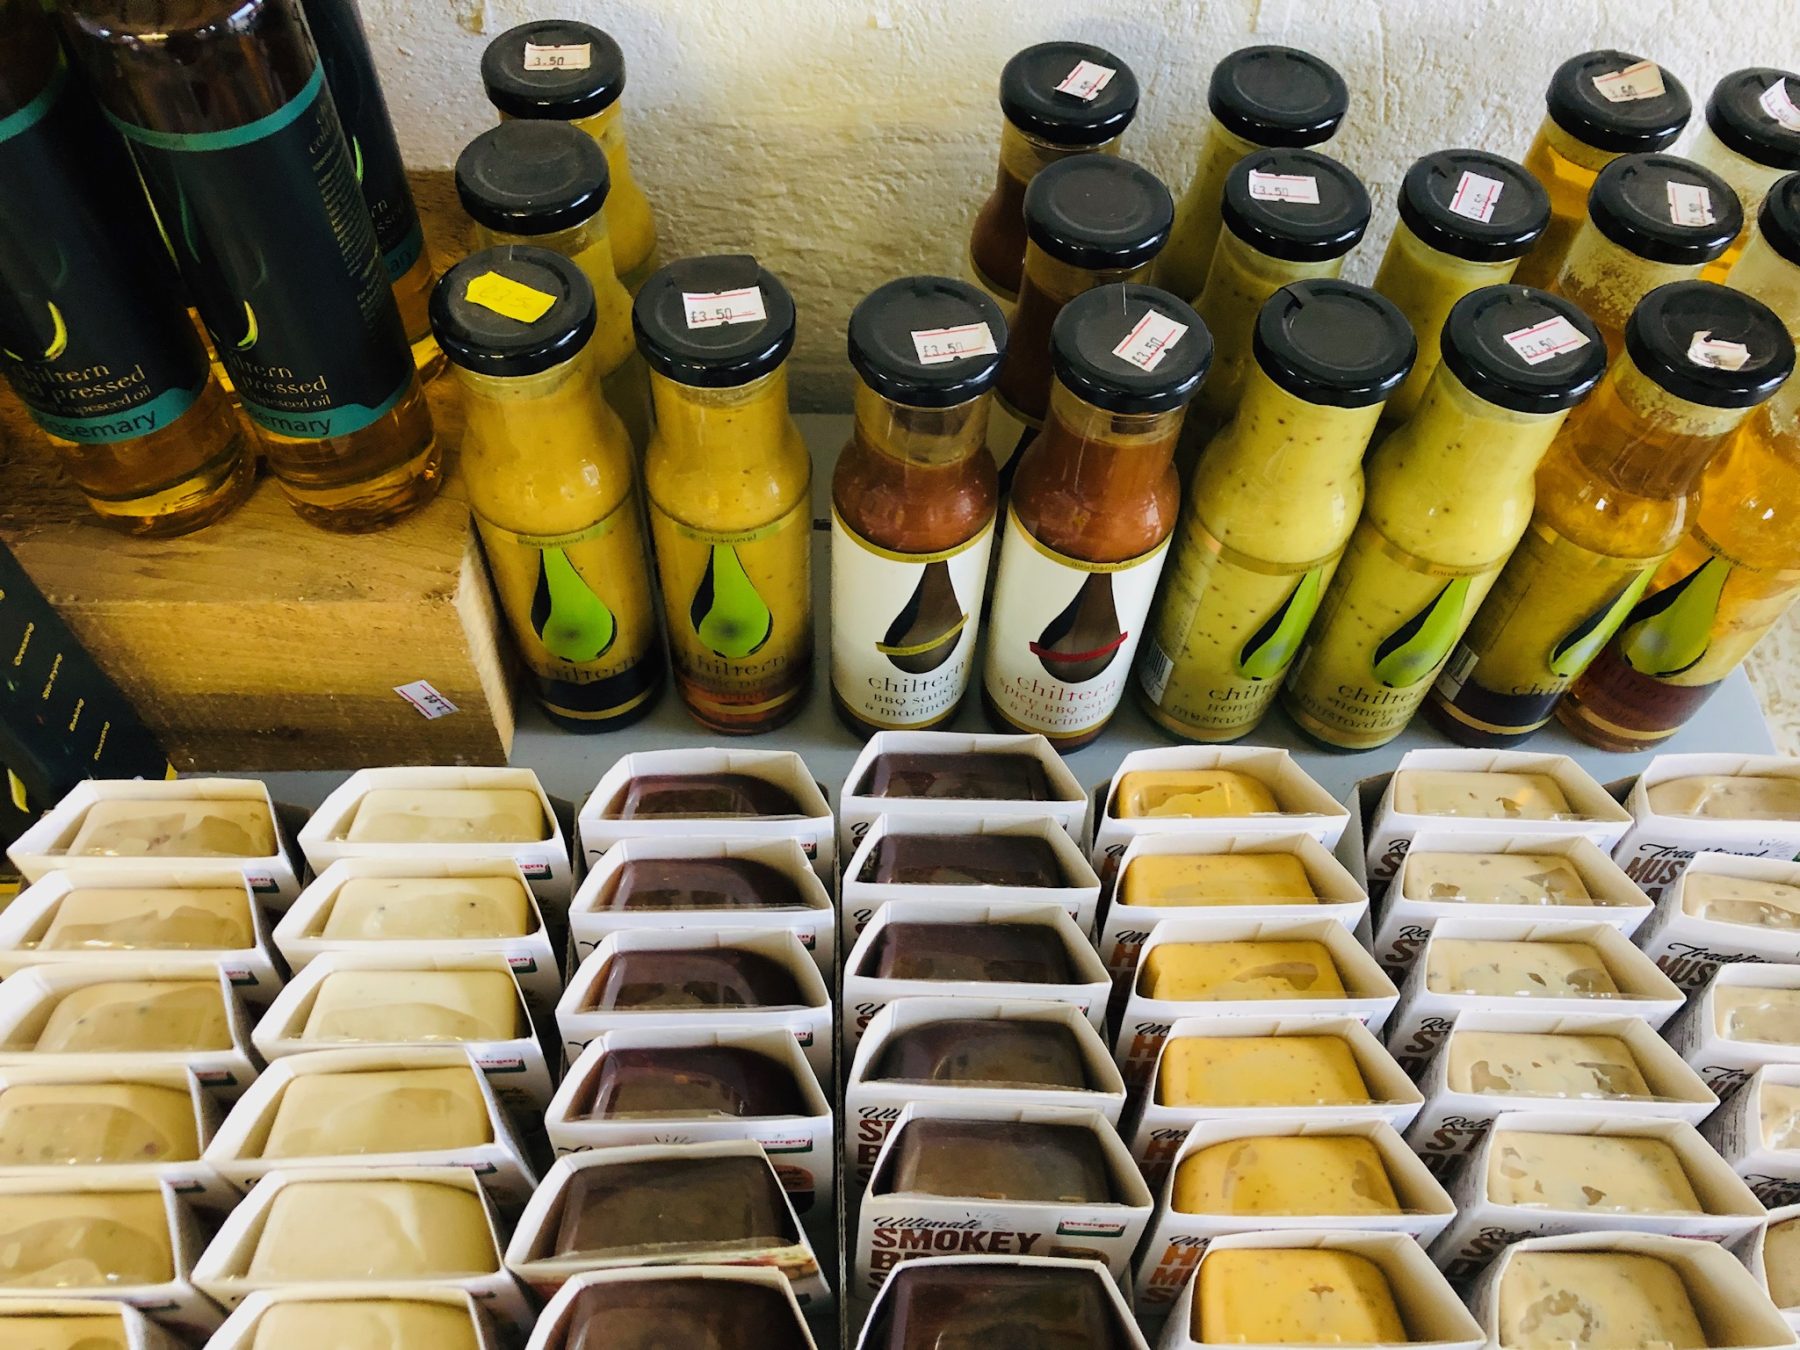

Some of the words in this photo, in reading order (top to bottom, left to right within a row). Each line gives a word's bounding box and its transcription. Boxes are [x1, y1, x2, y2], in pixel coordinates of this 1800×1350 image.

[691, 307, 733, 324] £3.50
[923, 342, 964, 358] £3.50
[1131, 337, 1164, 366] £3.50
[1519, 337, 1556, 359] £3.50
[52, 363, 146, 404] pressed
[133, 384, 152, 401] oil
[312, 394, 332, 408] oil
[874, 693, 907, 706] BBQ
[872, 1215, 983, 1231] Ultimate
[871, 1227, 1043, 1254] SMOKEY
